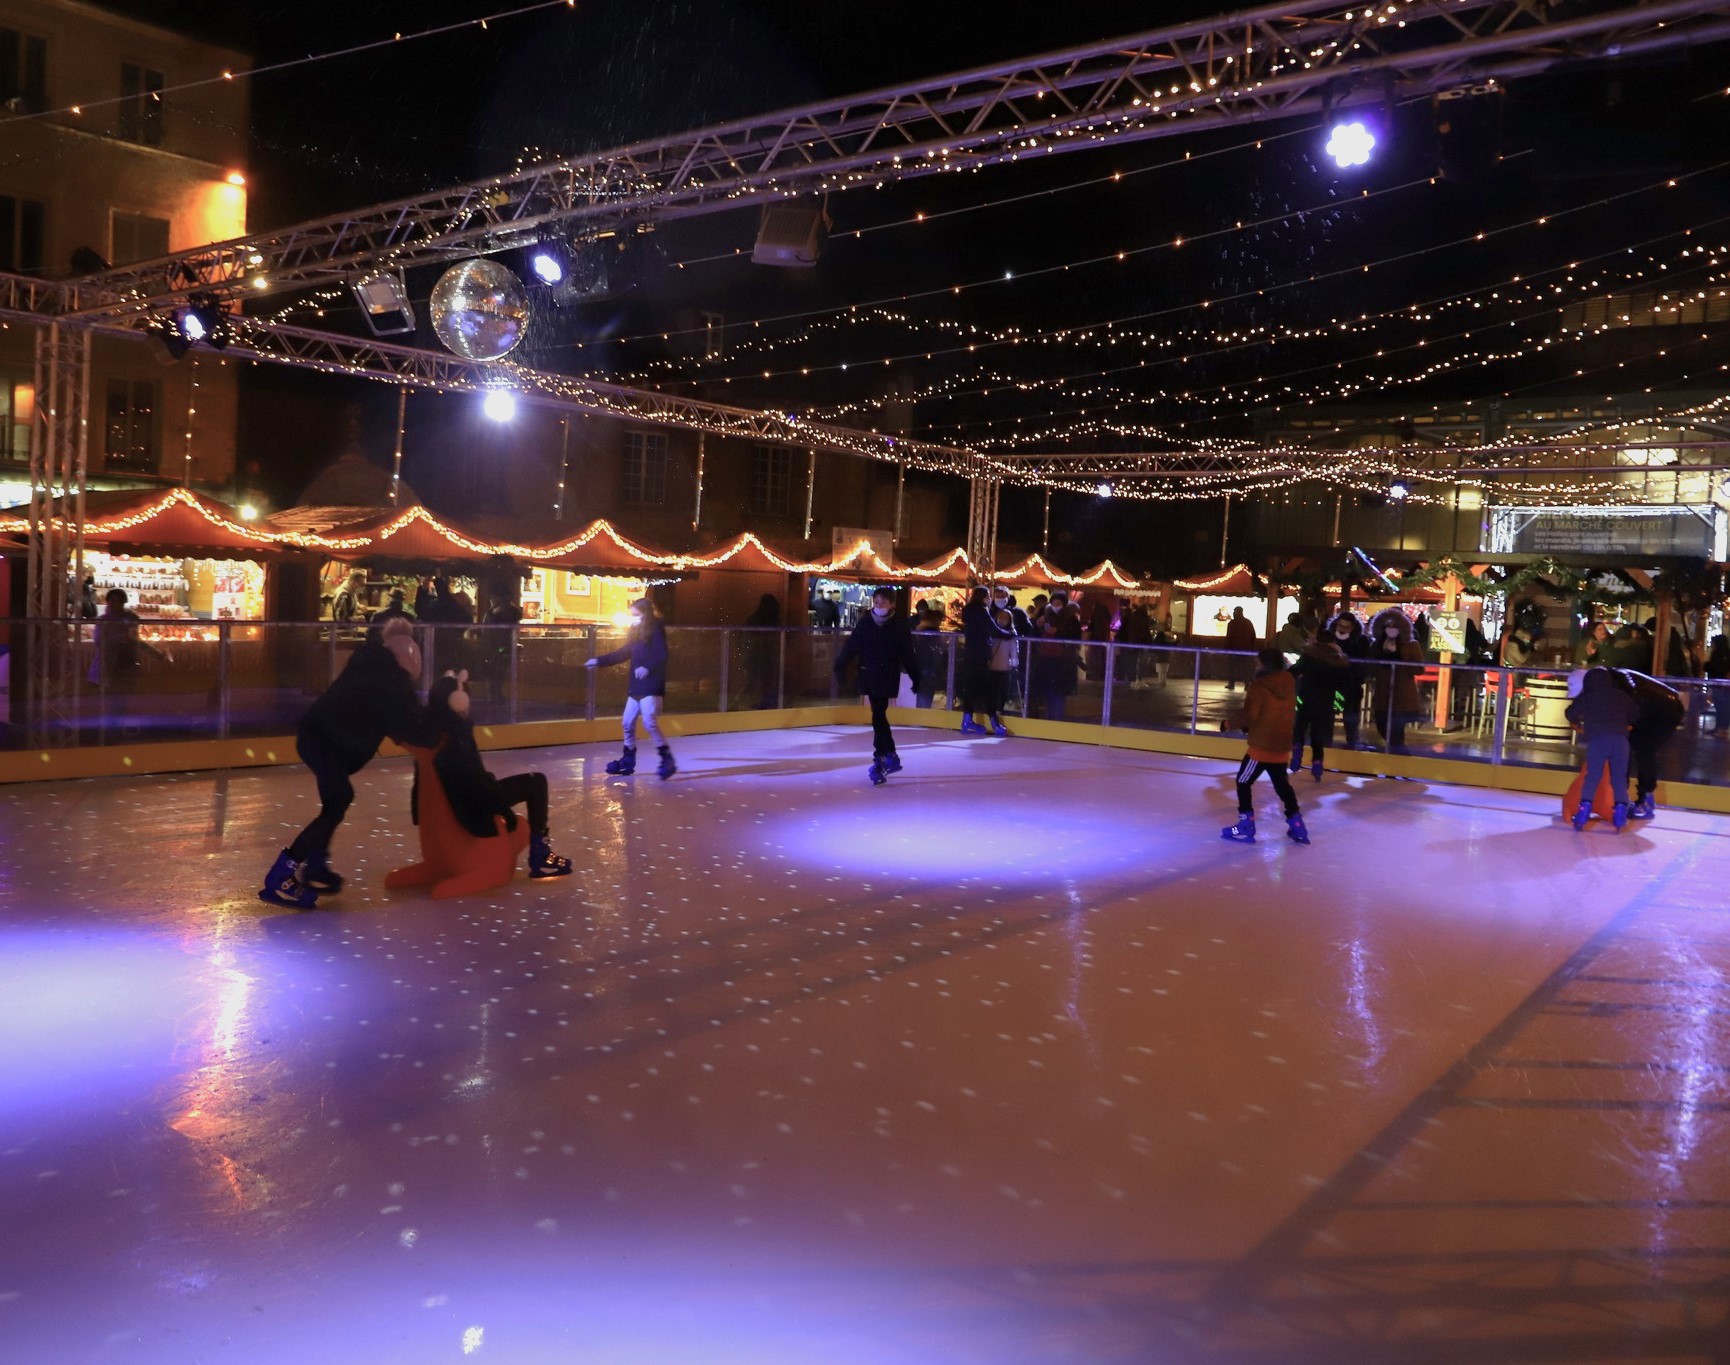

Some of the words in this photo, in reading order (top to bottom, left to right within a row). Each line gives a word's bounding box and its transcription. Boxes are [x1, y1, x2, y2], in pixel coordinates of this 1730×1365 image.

[1535, 520, 1552, 530] AU
[1554, 519, 1603, 530] MARCHÉ
[1606, 520, 1663, 530] COUVERT
